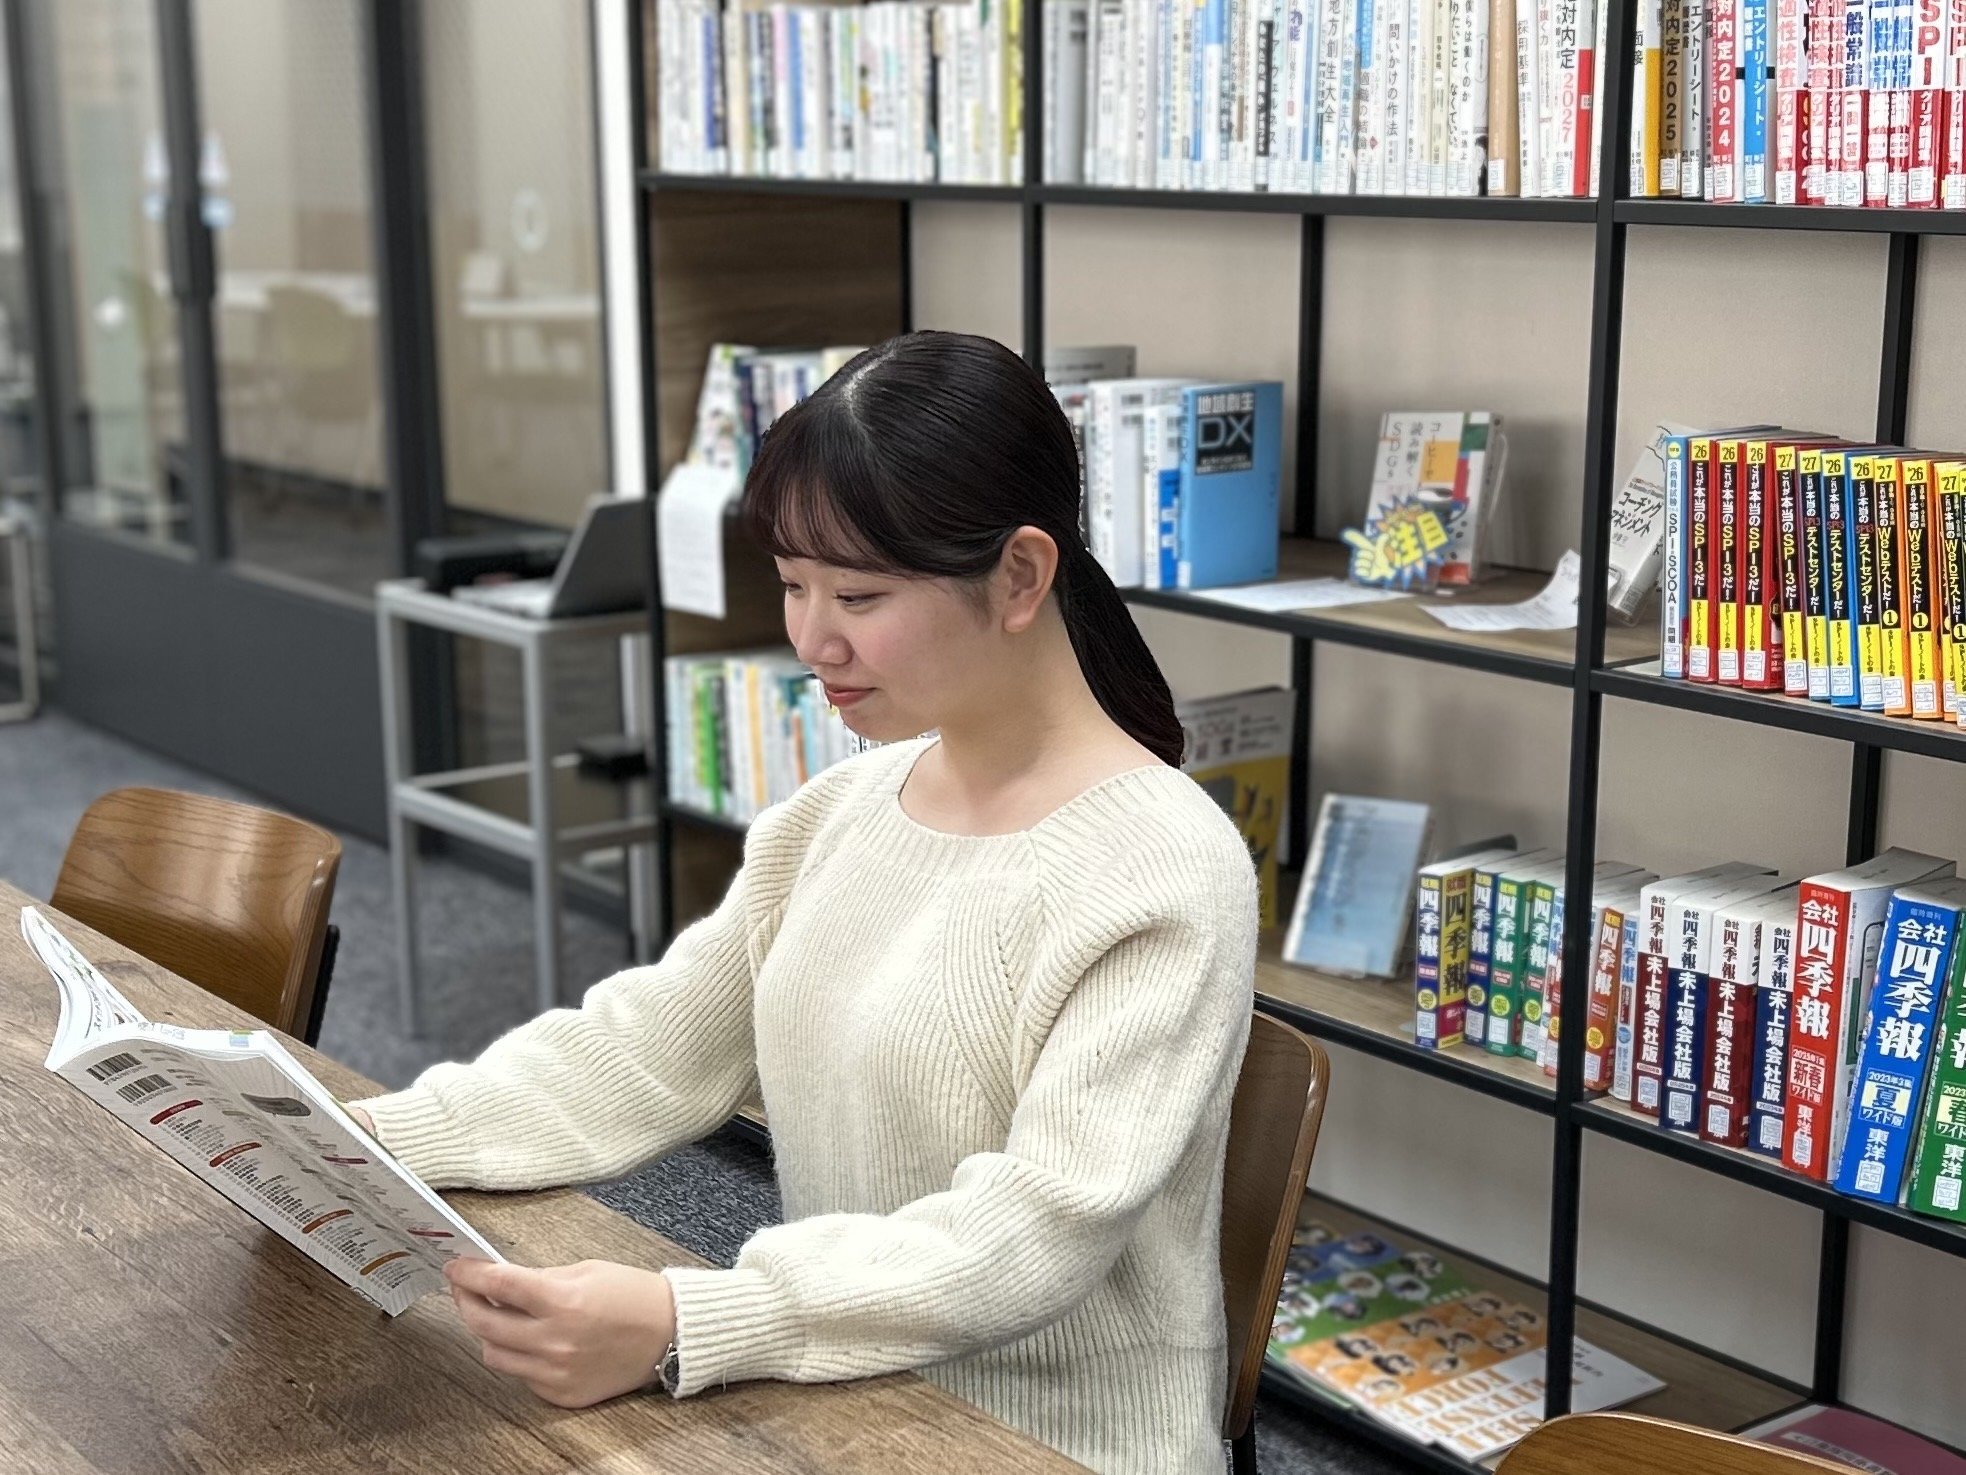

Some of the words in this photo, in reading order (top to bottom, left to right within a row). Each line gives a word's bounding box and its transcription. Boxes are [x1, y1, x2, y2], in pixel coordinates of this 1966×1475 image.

[1517, 20, 1529, 87] 採用基準
[1918, 0, 1941, 86] SPI
[1386, 24, 1400, 137] 問いかけの作法
[1560, 0, 1577, 143] 対内定2027
[1198, 414, 1253, 449] DX
[1619, 491, 1663, 518] コーチング
[1649, 904, 1665, 954] 四季報
[1802, 900, 1839, 926] 会社
[1897, 918, 1947, 946] 会社
[1444, 892, 1467, 996] 四季報
[1681, 920, 1698, 969] 四季報
[1722, 929, 1738, 980] 四季報
[1771, 937, 1789, 989] 四季報
[1795, 920, 1837, 1039] 四季報
[1876, 938, 1942, 1062] 四季報
[1642, 957, 1663, 1063] 未上場会社版
[1673, 971, 1696, 1079] 未上場会社版
[1713, 982, 1736, 1091] 未上場会社版
[1762, 990, 1787, 1102] 未上場会社版
[1862, 1107, 1904, 1127] ワイド版
[1872, 1085, 1901, 1113] 夏
[1863, 1127, 1890, 1161] 東洋
[1940, 1142, 1966, 1178] 東洋
